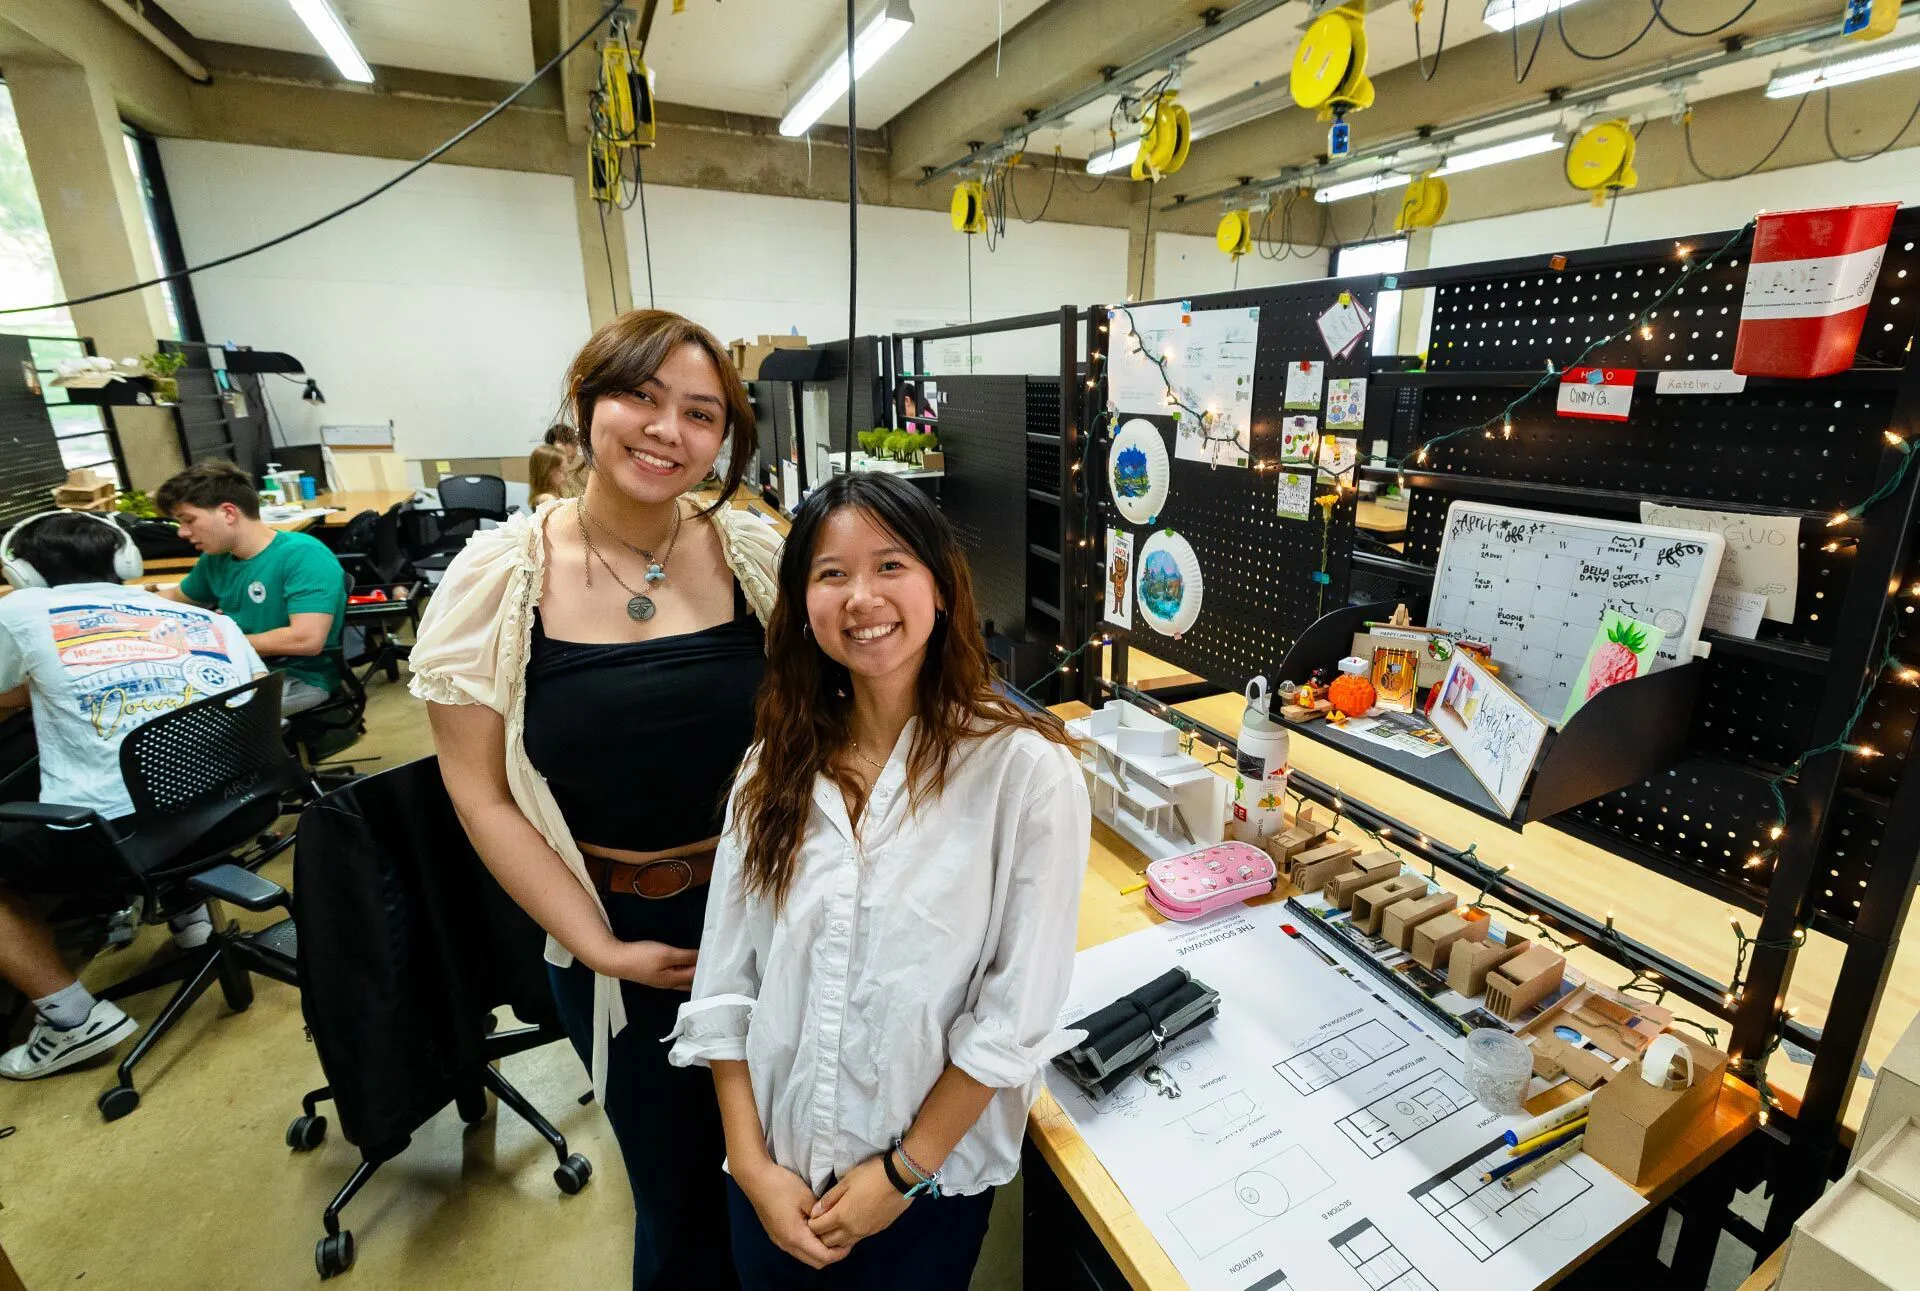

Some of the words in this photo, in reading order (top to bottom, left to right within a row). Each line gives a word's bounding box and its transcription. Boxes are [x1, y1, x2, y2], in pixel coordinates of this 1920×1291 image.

[1569, 387, 1595, 406] CINDY
[1724, 523, 1786, 546] GUO
[1607, 546, 1633, 554] meow
[1582, 565, 1610, 577] BELLA
[1497, 612, 1523, 621] ELODIE
[1239, 923, 1256, 935] THE
[1176, 930, 1237, 956] SOUNDWAVE
[1199, 1074, 1227, 1090] DIAGRAMS
[1249, 1128, 1282, 1148] PENTHOUSE
[1327, 1199, 1352, 1215] SECTION
[1229, 1250, 1264, 1274] ELEVATION
